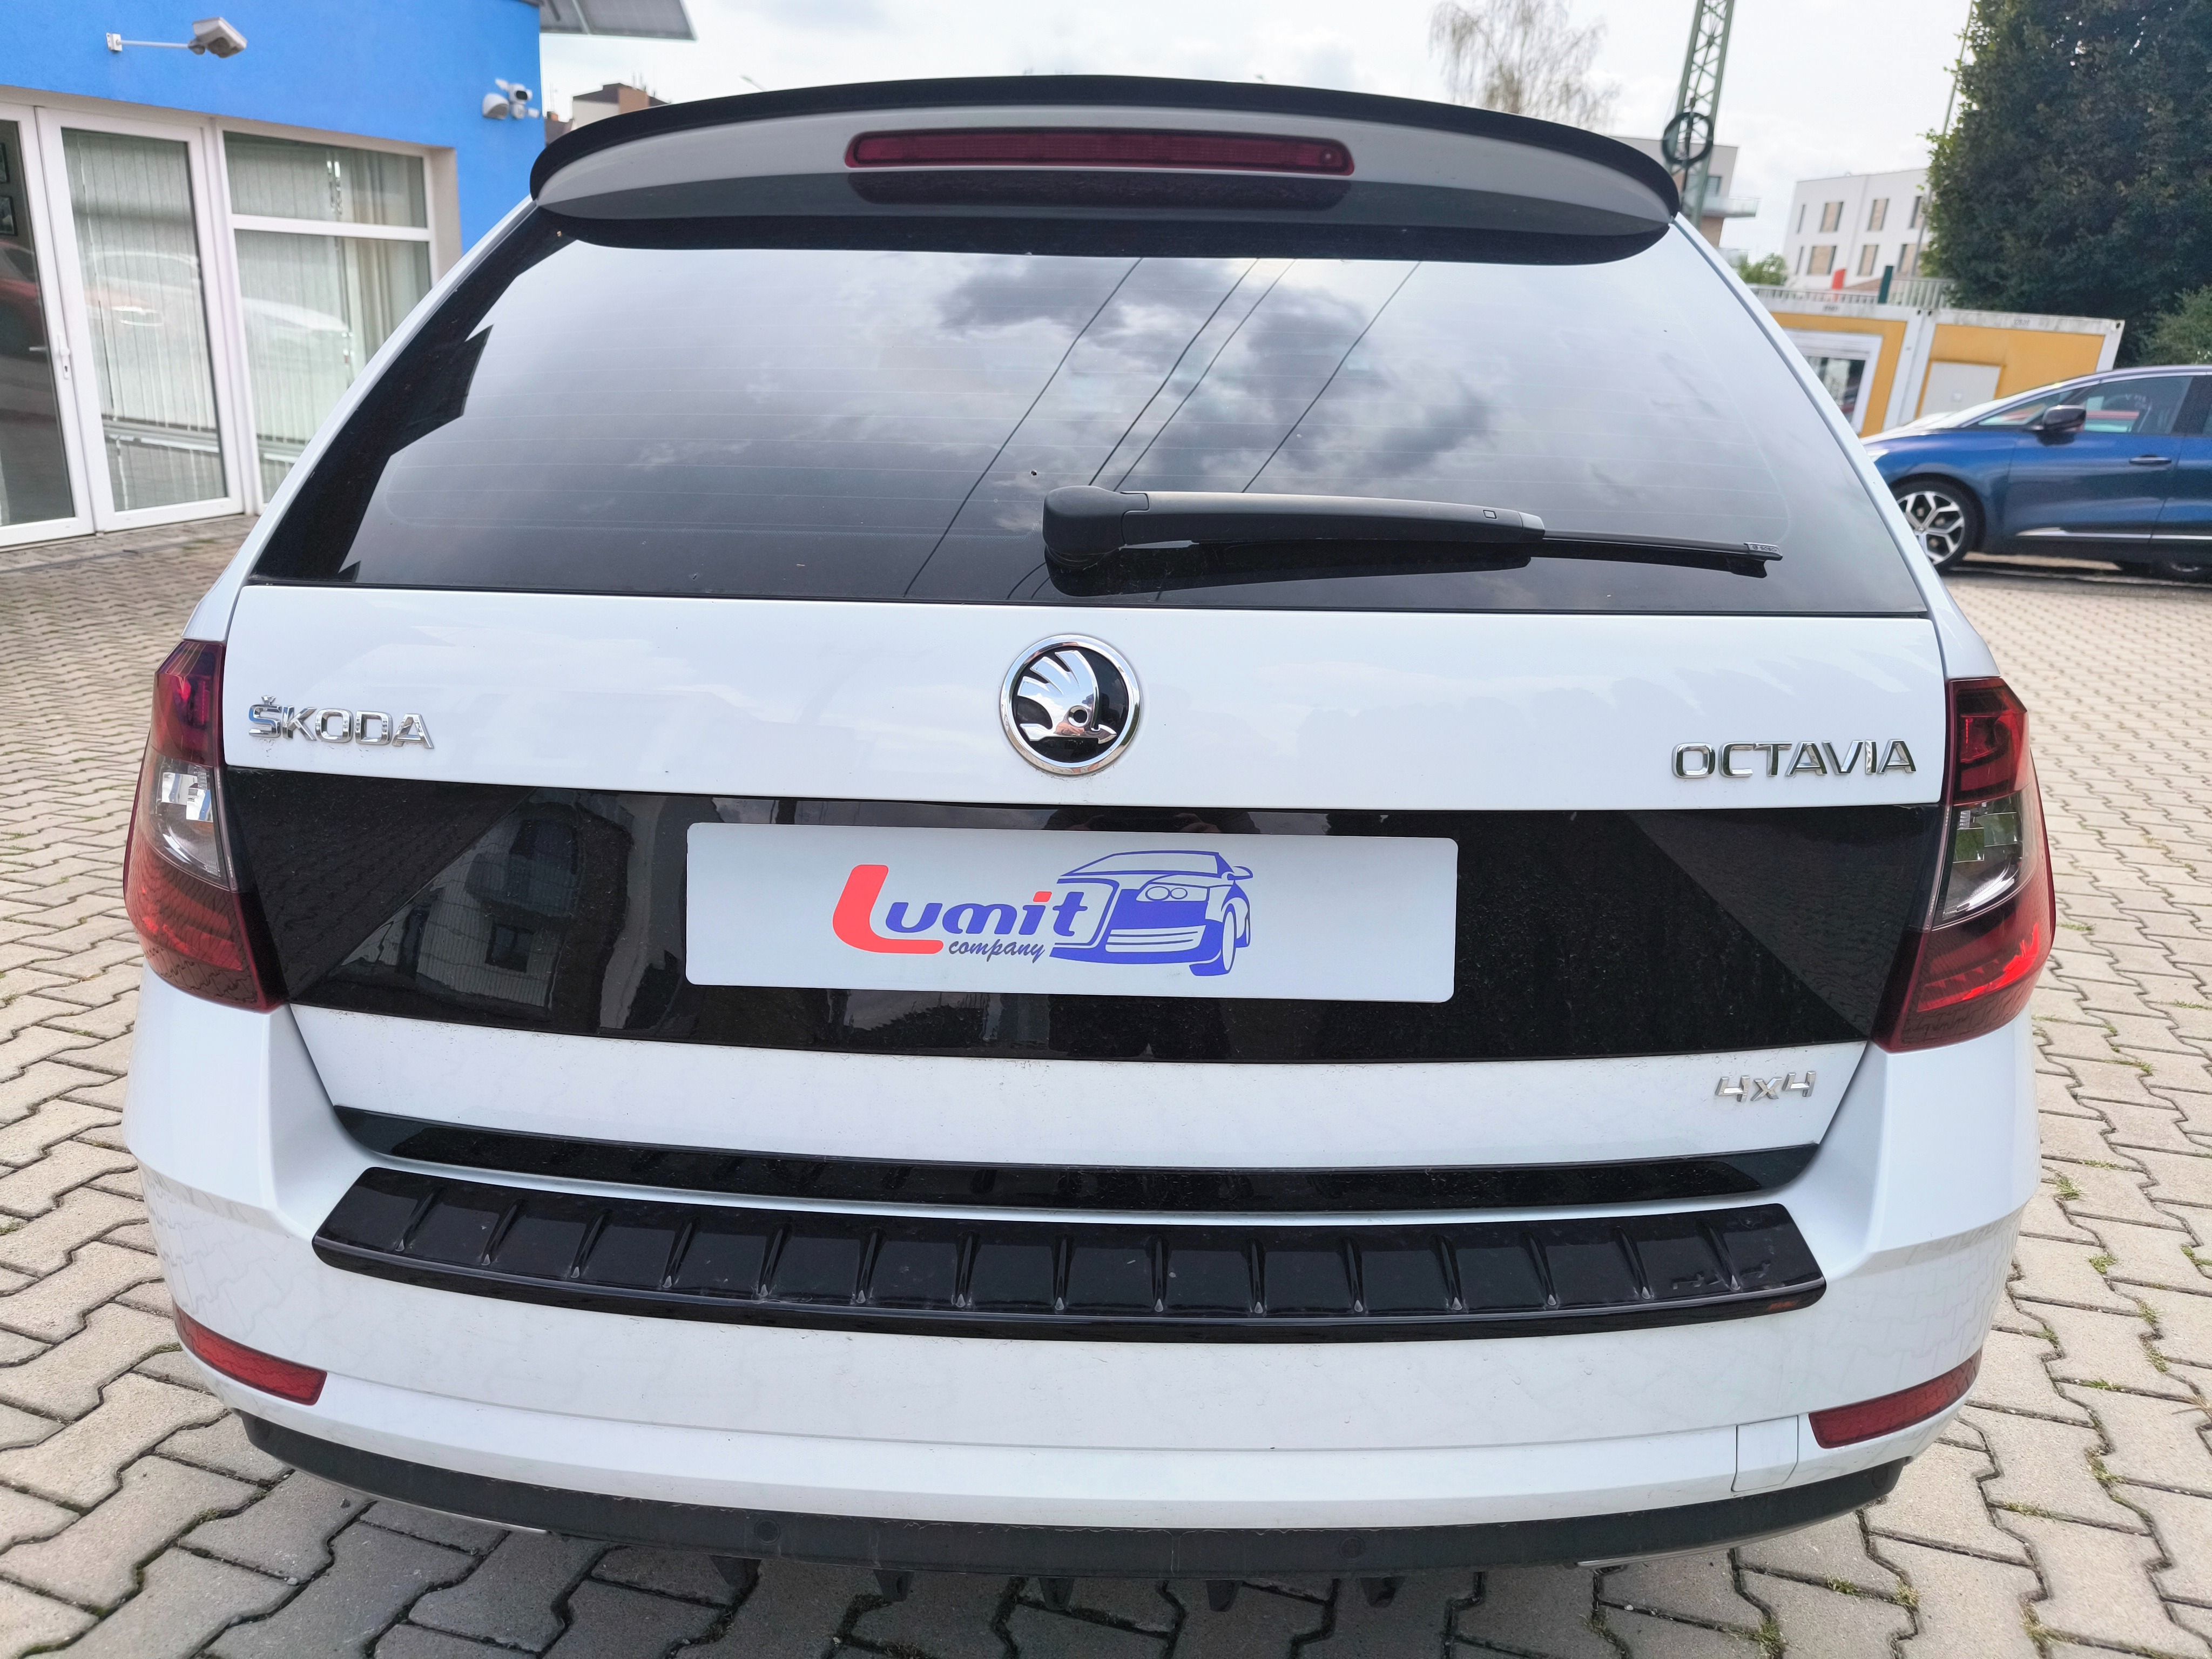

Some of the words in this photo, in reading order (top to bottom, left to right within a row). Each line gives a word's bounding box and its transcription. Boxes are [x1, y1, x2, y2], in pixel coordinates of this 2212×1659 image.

[248, 695, 434, 750] ŠKODA
[1671, 738, 1917, 778] OCTAVIA
[832, 864, 1088, 954] Lumit
[948, 939, 1046, 963] company
